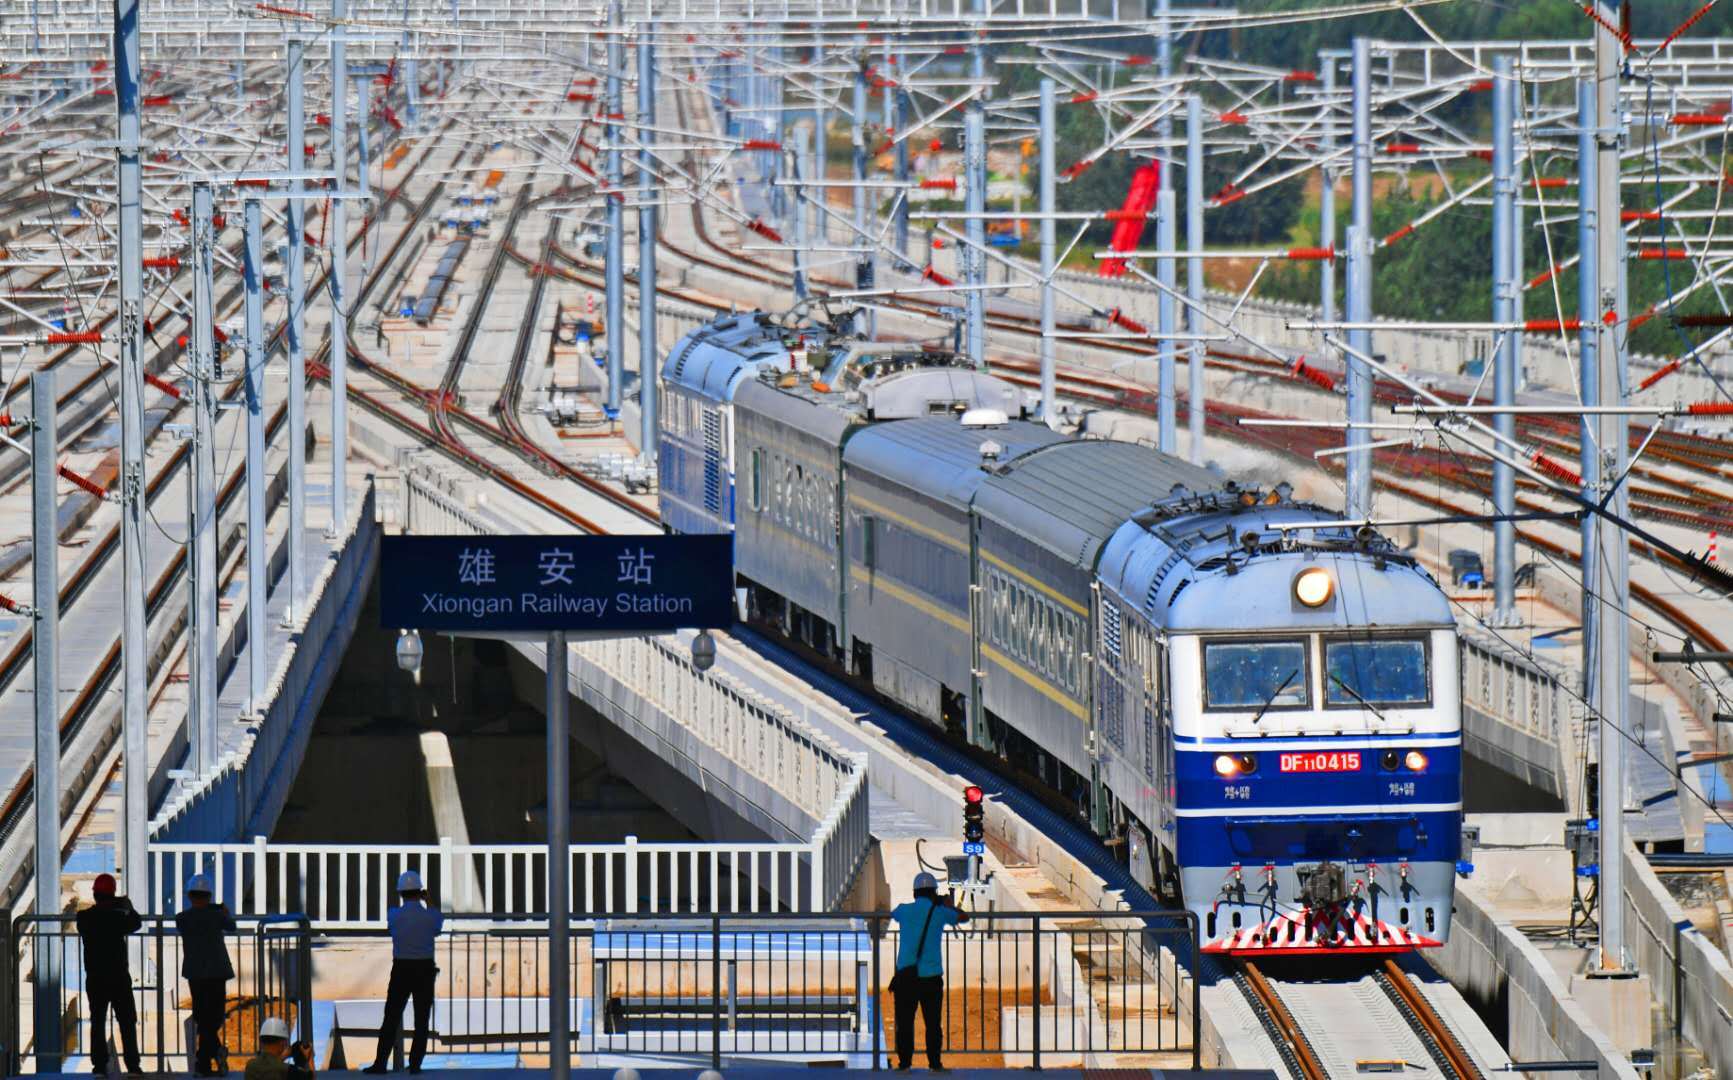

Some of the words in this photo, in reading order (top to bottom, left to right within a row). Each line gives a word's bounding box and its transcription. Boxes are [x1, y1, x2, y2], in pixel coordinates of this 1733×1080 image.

[458, 547, 655, 586] 雄安站
[422, 592, 513, 618] Xiongan
[521, 592, 608, 618] Railway
[615, 592, 692, 613] Station
